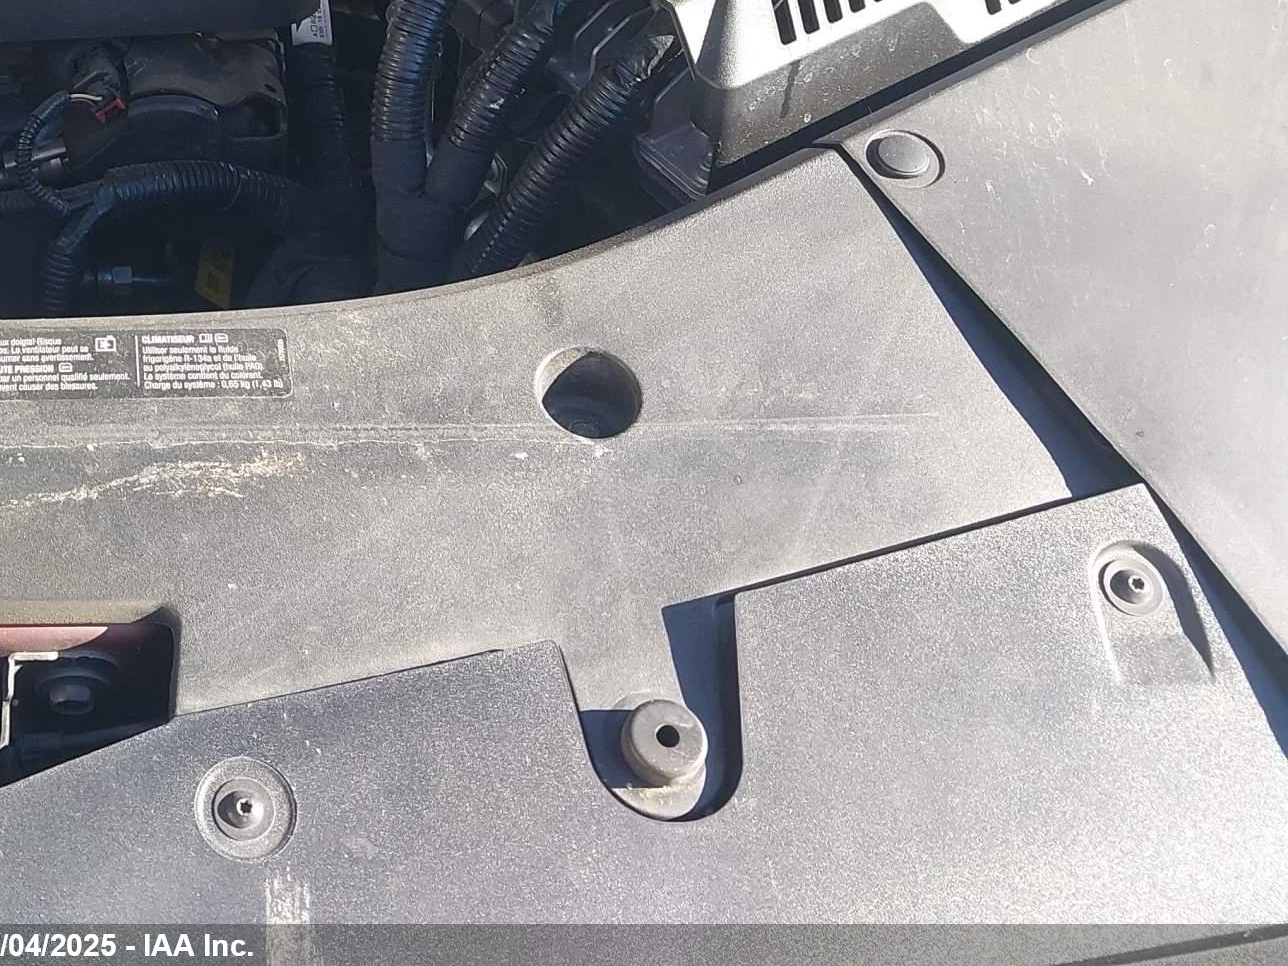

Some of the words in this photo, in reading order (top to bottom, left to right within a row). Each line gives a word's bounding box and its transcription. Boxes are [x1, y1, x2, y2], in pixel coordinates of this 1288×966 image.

[37, 337, 62, 346] Risque
[142, 335, 194, 344] CLIMATISEUR
[11, 346, 21, 354] Le
[22, 346, 60, 354] ventilateur
[62, 345, 78, 354] peut
[80, 345, 88, 353] se
[142, 346, 168, 354] Utiliser
[169, 346, 208, 354] seulement
[218, 345, 239, 353] fluide
[41, 353, 94, 363] avertissement.
[184, 354, 212, 363] R-134a
[213, 354, 221, 362] et
[223, 354, 232, 362] de
[14, 364, 54, 374] PRESSION
[143, 364, 153, 372] au
[223, 362, 243, 372] (huile
[23, 373, 59, 383] personnel
[61, 372, 88, 382] qualifié
[89, 372, 130, 381] seulement.
[144, 372, 153, 380] Le
[154, 372, 186, 382] système
[187, 371, 218, 380] contient
[219, 371, 229, 379] du
[230, 371, 263, 379] colorant.
[18, 383, 43, 391] causer
[45, 382, 59, 391] des
[60, 382, 98, 391] blessures.
[144, 380, 171, 390] Charge
[172, 380, 183, 389] du
[184, 380, 215, 390] système
[240, 379, 250, 389] kg
[273, 378, 284, 388] lb)
